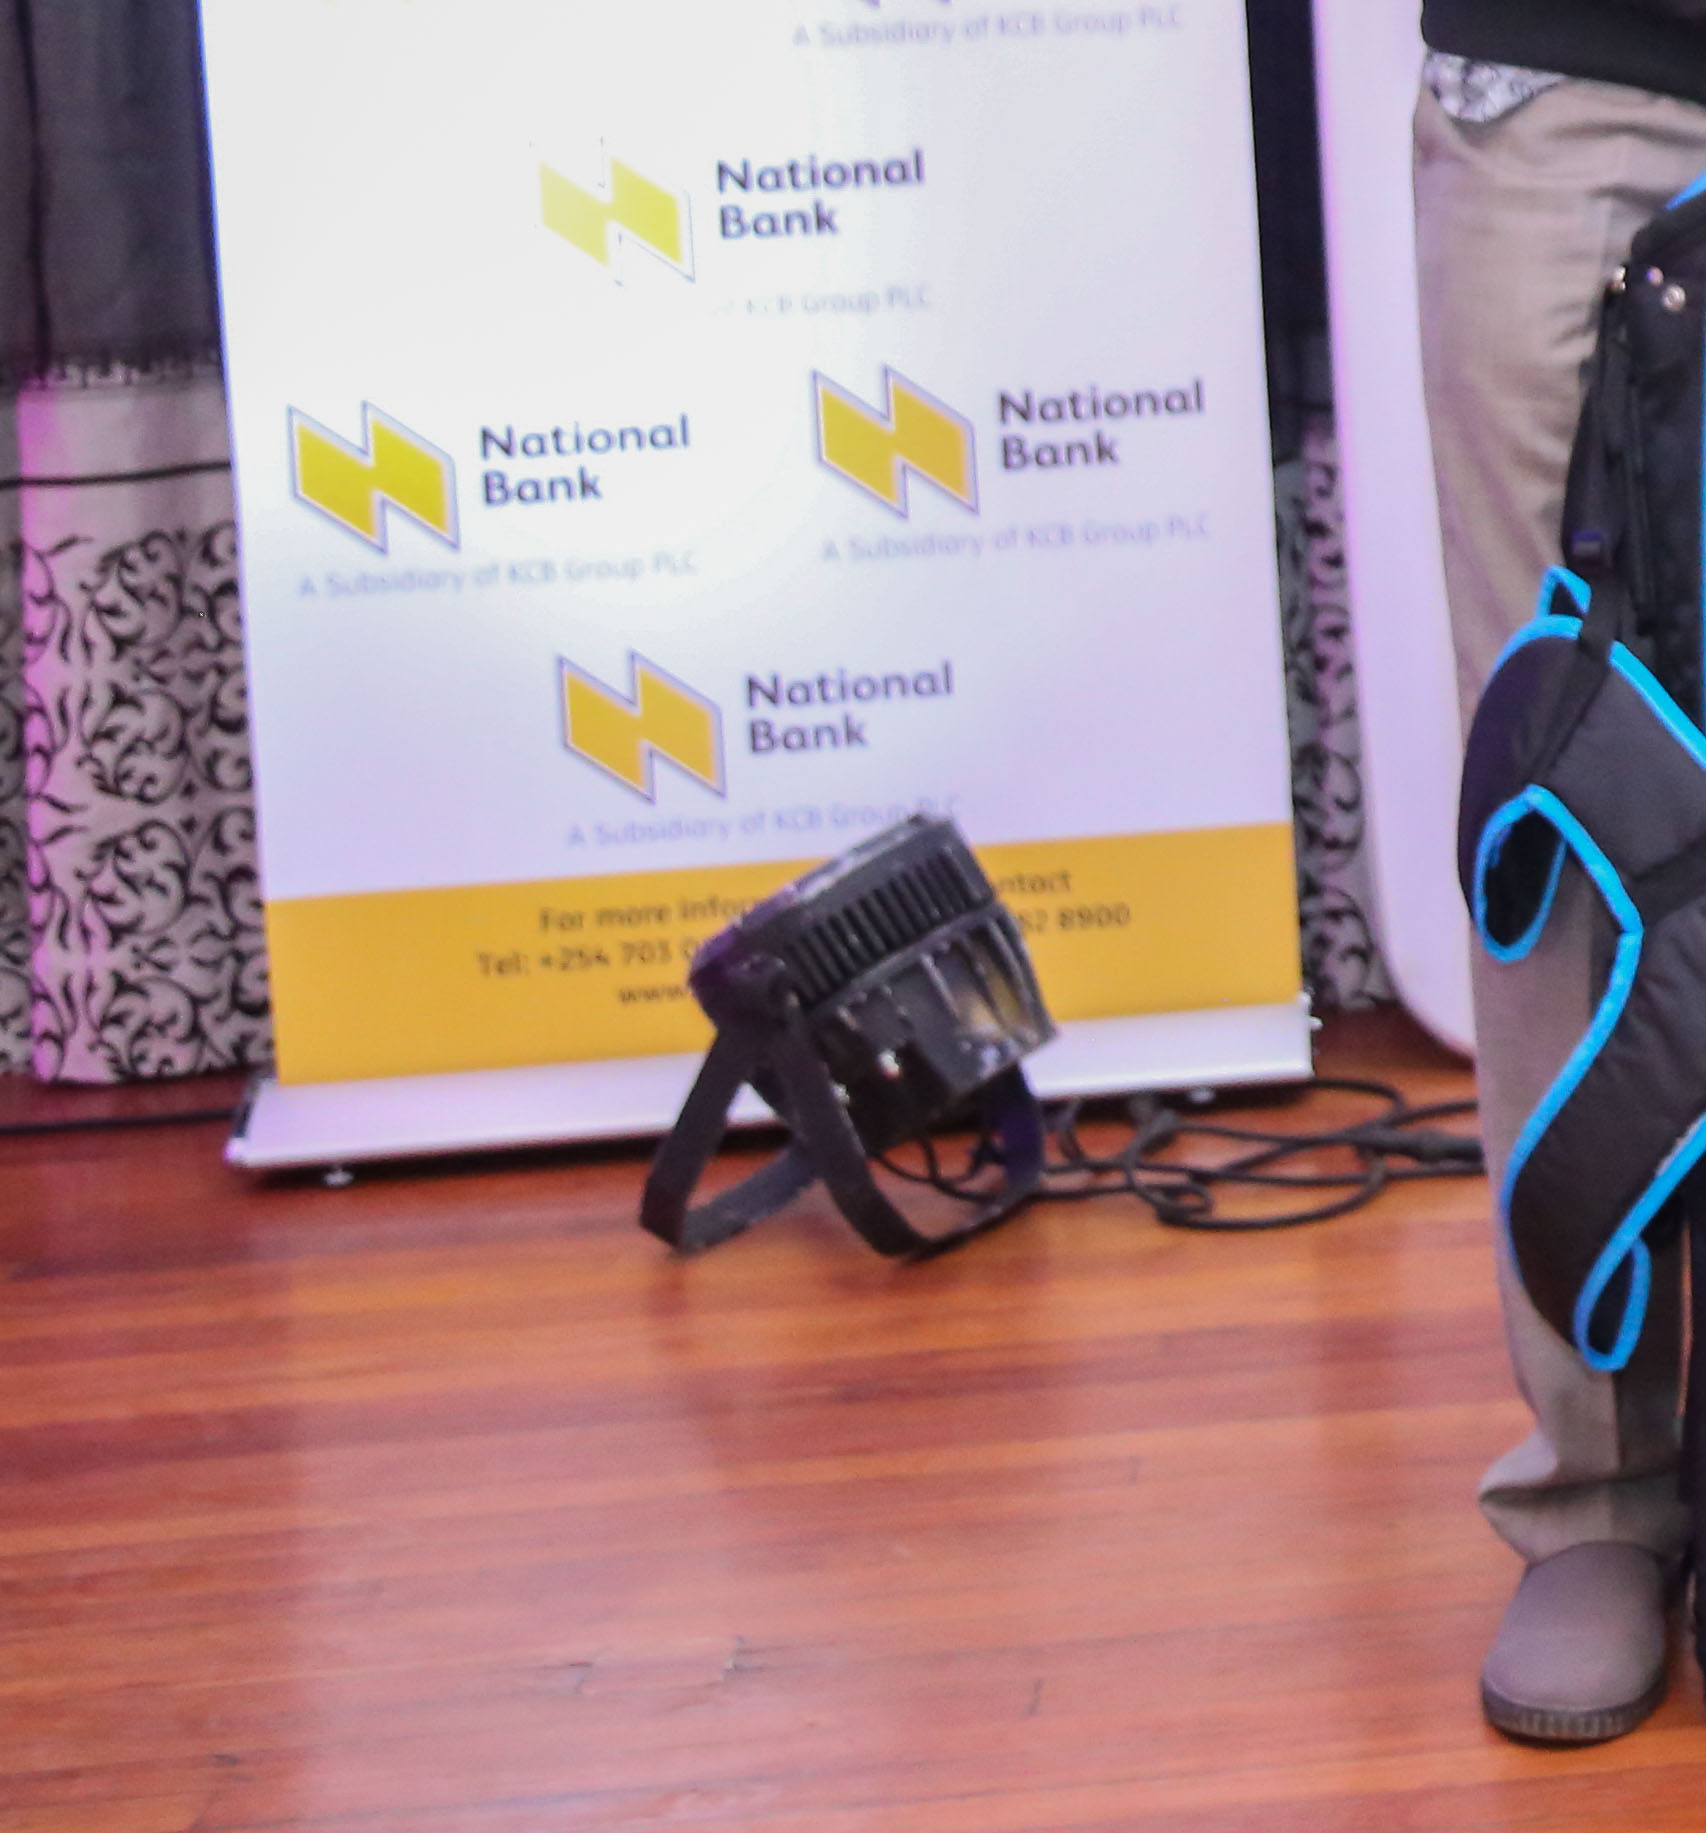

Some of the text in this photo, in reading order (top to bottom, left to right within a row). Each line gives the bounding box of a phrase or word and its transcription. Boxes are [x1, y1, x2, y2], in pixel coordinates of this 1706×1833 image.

[717, 148, 924, 193] National
[719, 200, 837, 239] Bank
[998, 379, 1204, 425] National
[480, 414, 689, 460] National
[1001, 431, 1118, 471] Bank
[482, 467, 601, 506] Bank
[745, 661, 953, 710] National
[748, 714, 866, 755] Bank
[998, 870, 1072, 895] ntact
[539, 907, 584, 933] For
[595, 903, 671, 928] more
